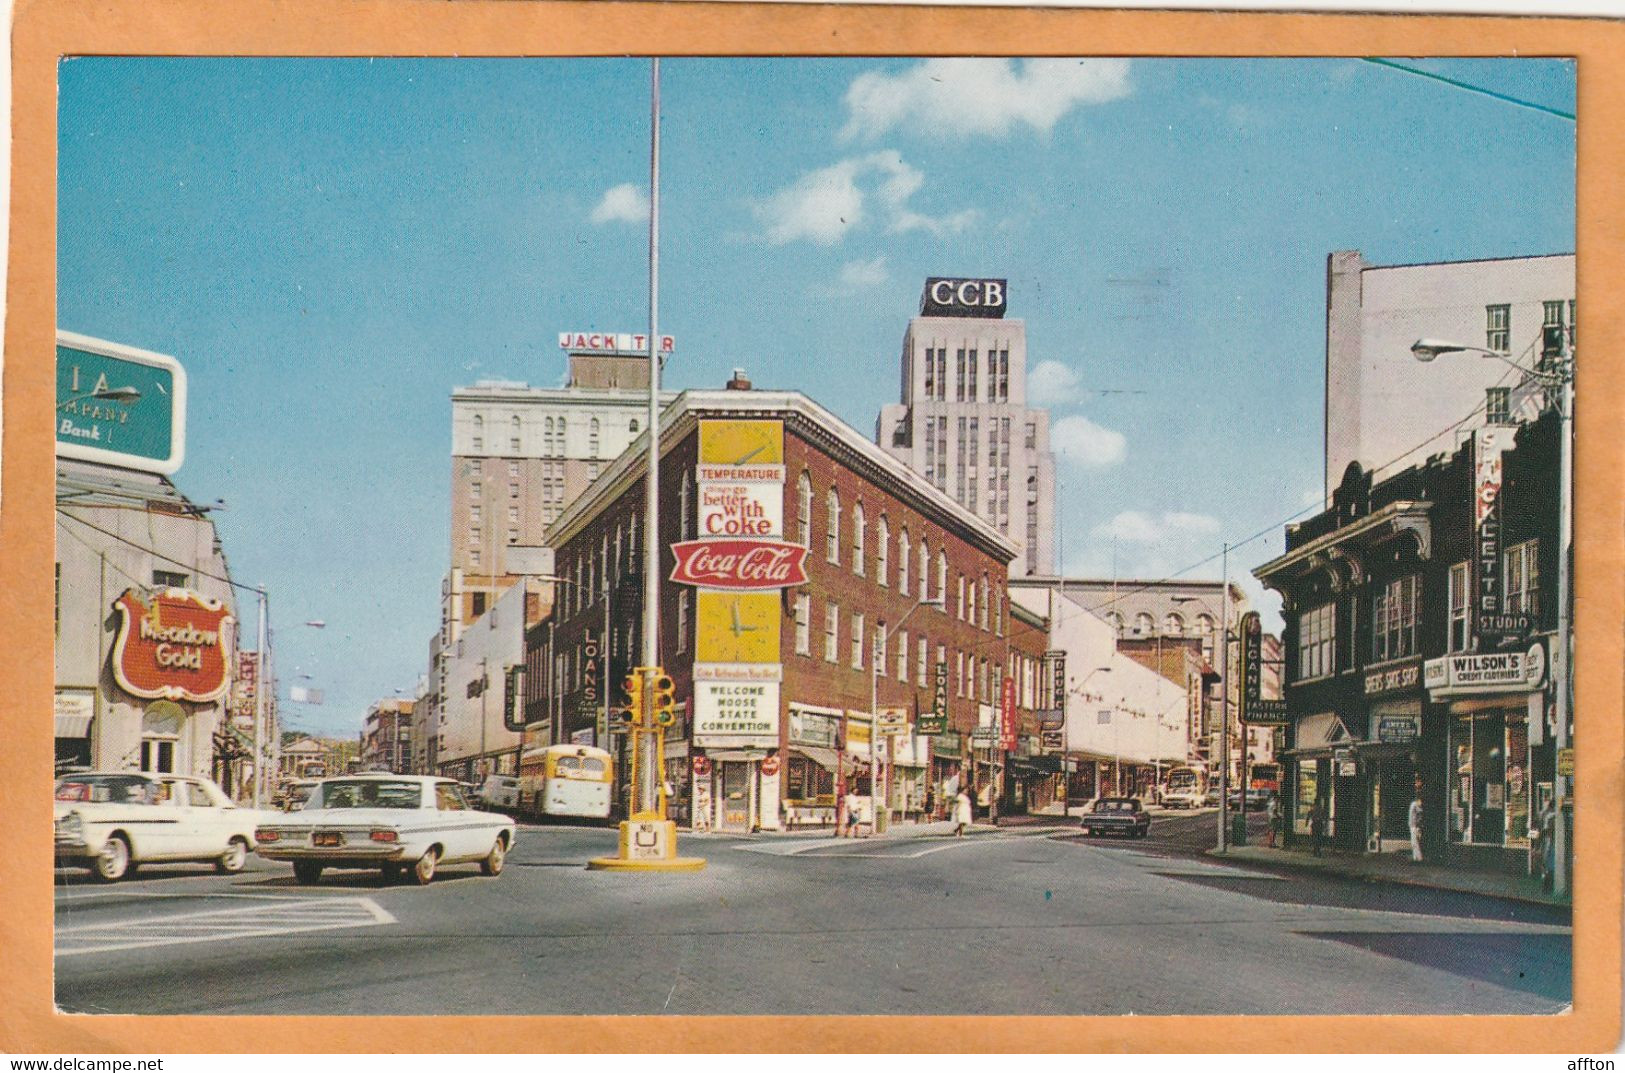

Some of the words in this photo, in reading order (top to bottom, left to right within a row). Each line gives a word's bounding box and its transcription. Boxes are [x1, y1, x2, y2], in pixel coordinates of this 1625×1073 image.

[931, 281, 1003, 306] CCB
[561, 335, 615, 349] JACK
[634, 336, 673, 351] TR
[60, 419, 100, 440] Bank
[702, 469, 780, 479] TEMPERATURE
[703, 492, 747, 506] better
[724, 500, 764, 517] with
[706, 513, 772, 535] Coke
[140, 614, 218, 646] Meadow
[1480, 615, 1528, 629] STUDIO
[155, 643, 202, 669] Gold
[1453, 655, 1519, 671] WILSON'S
[585, 629, 598, 700] LOANS
[1247, 640, 1257, 698] LOANS
[710, 687, 765, 695] WELCOME
[936, 665, 946, 717] LOANS
[718, 699, 756, 707] MOOSE
[719, 710, 757, 719] STATE
[701, 722, 771, 731] CONVENTION
